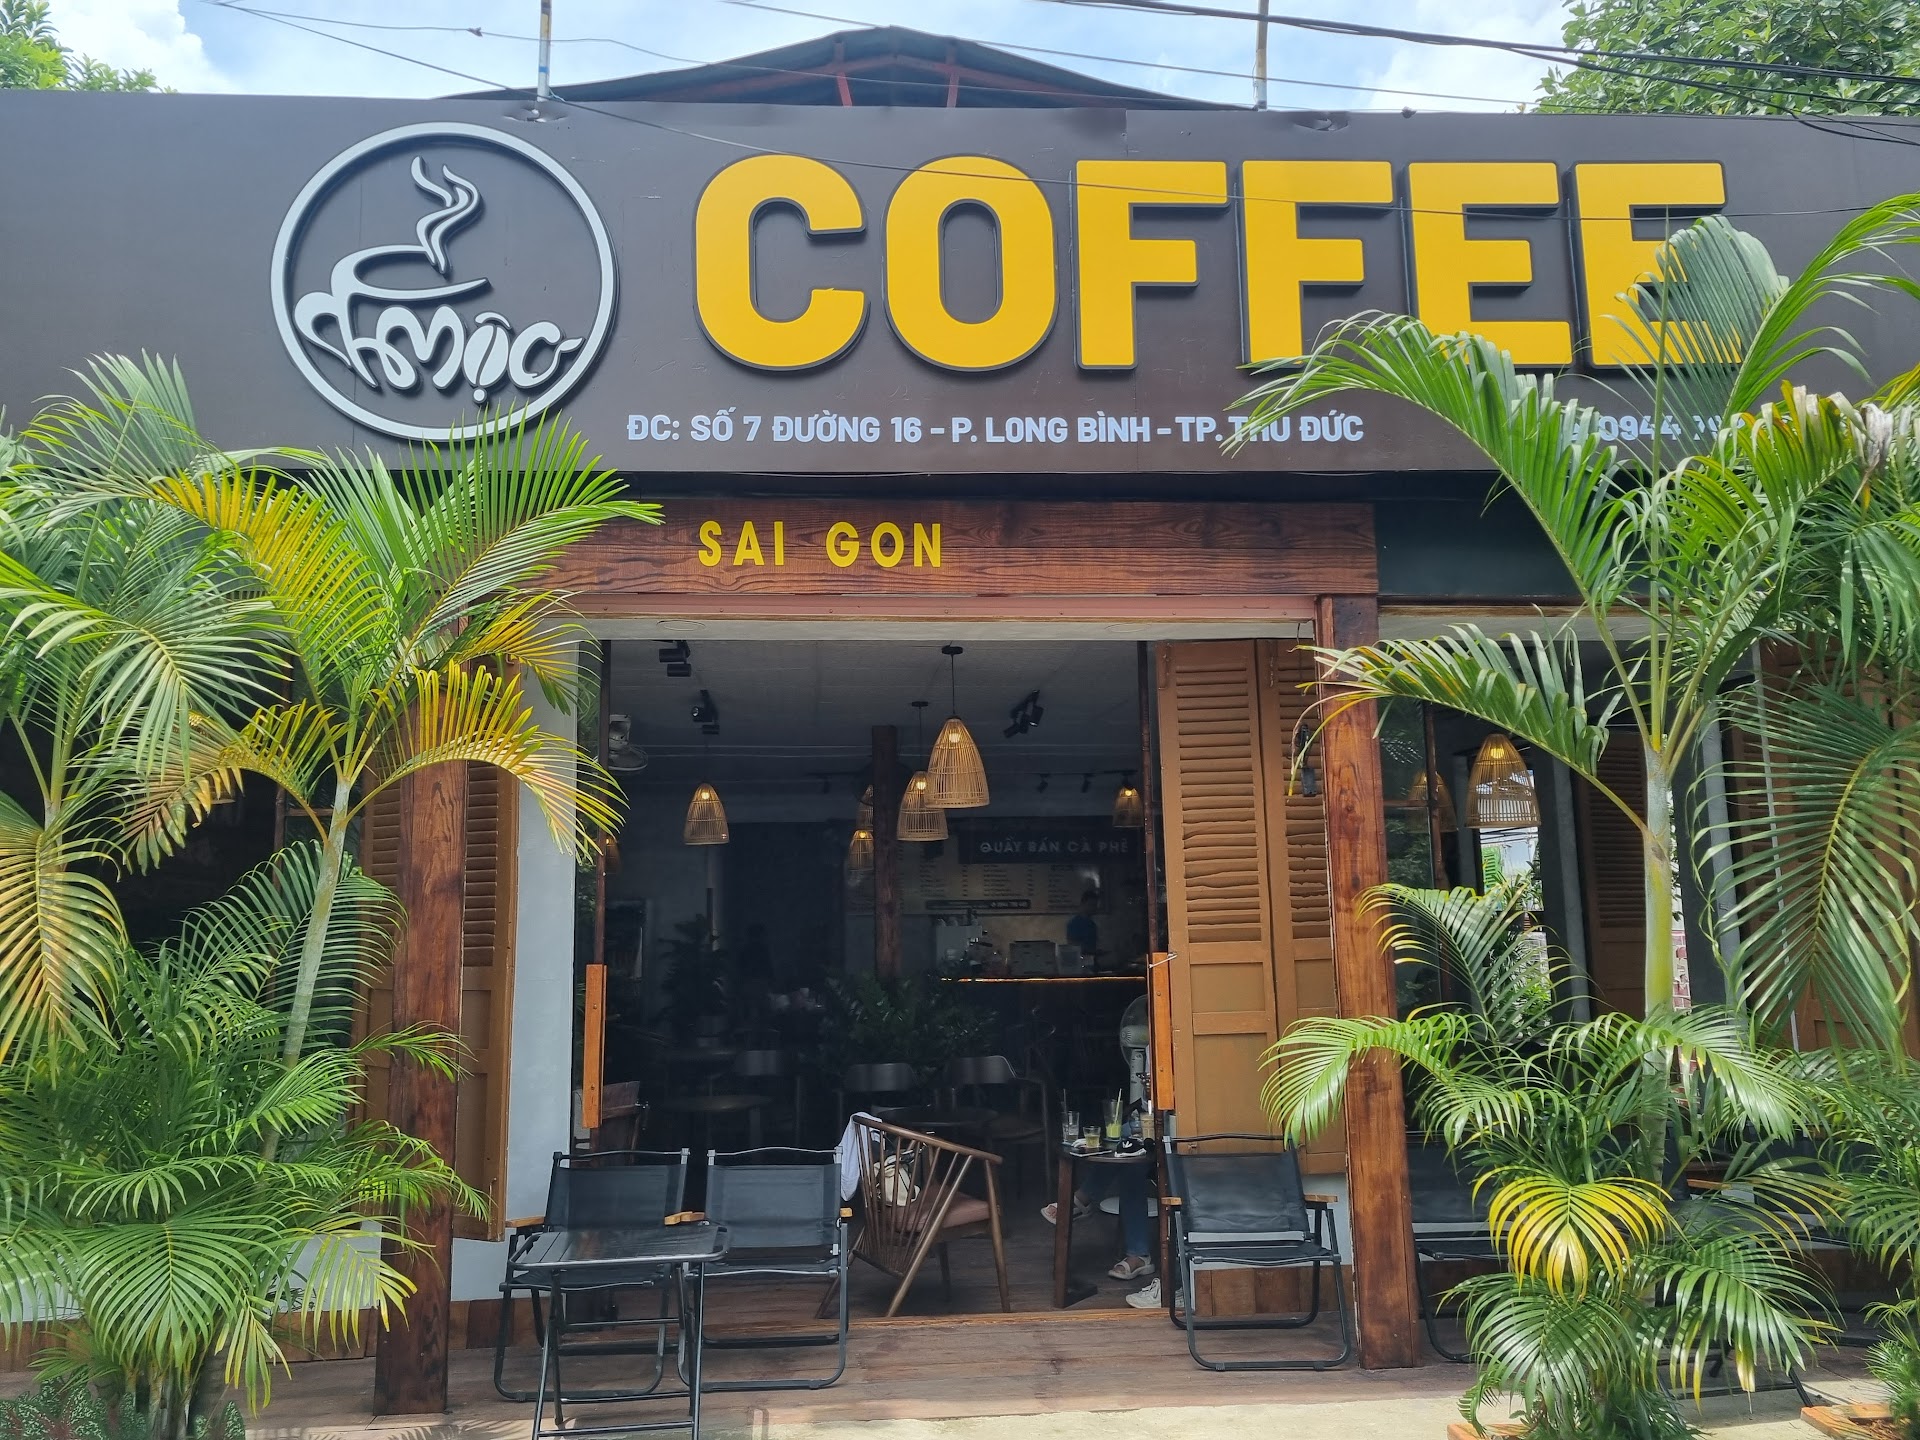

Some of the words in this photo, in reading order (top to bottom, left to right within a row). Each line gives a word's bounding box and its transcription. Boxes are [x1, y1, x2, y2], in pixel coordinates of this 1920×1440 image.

[694, 153, 1744, 370] COFFEE
[626, 413, 680, 441] ĐC:
[690, 406, 737, 441] SỐ
[743, 415, 762, 442] 7
[772, 409, 881, 442] ĐƯỜNG
[890, 416, 922, 443] 16
[952, 416, 978, 443] P.
[985, 416, 1068, 443] LONG
[1077, 410, 1151, 443] BÌNH
[1298, 409, 1365, 443] ĐỨC
[1598, 414, 1682, 442] 0944
[698, 520, 786, 567] SAI
[825, 521, 942, 568] GON
